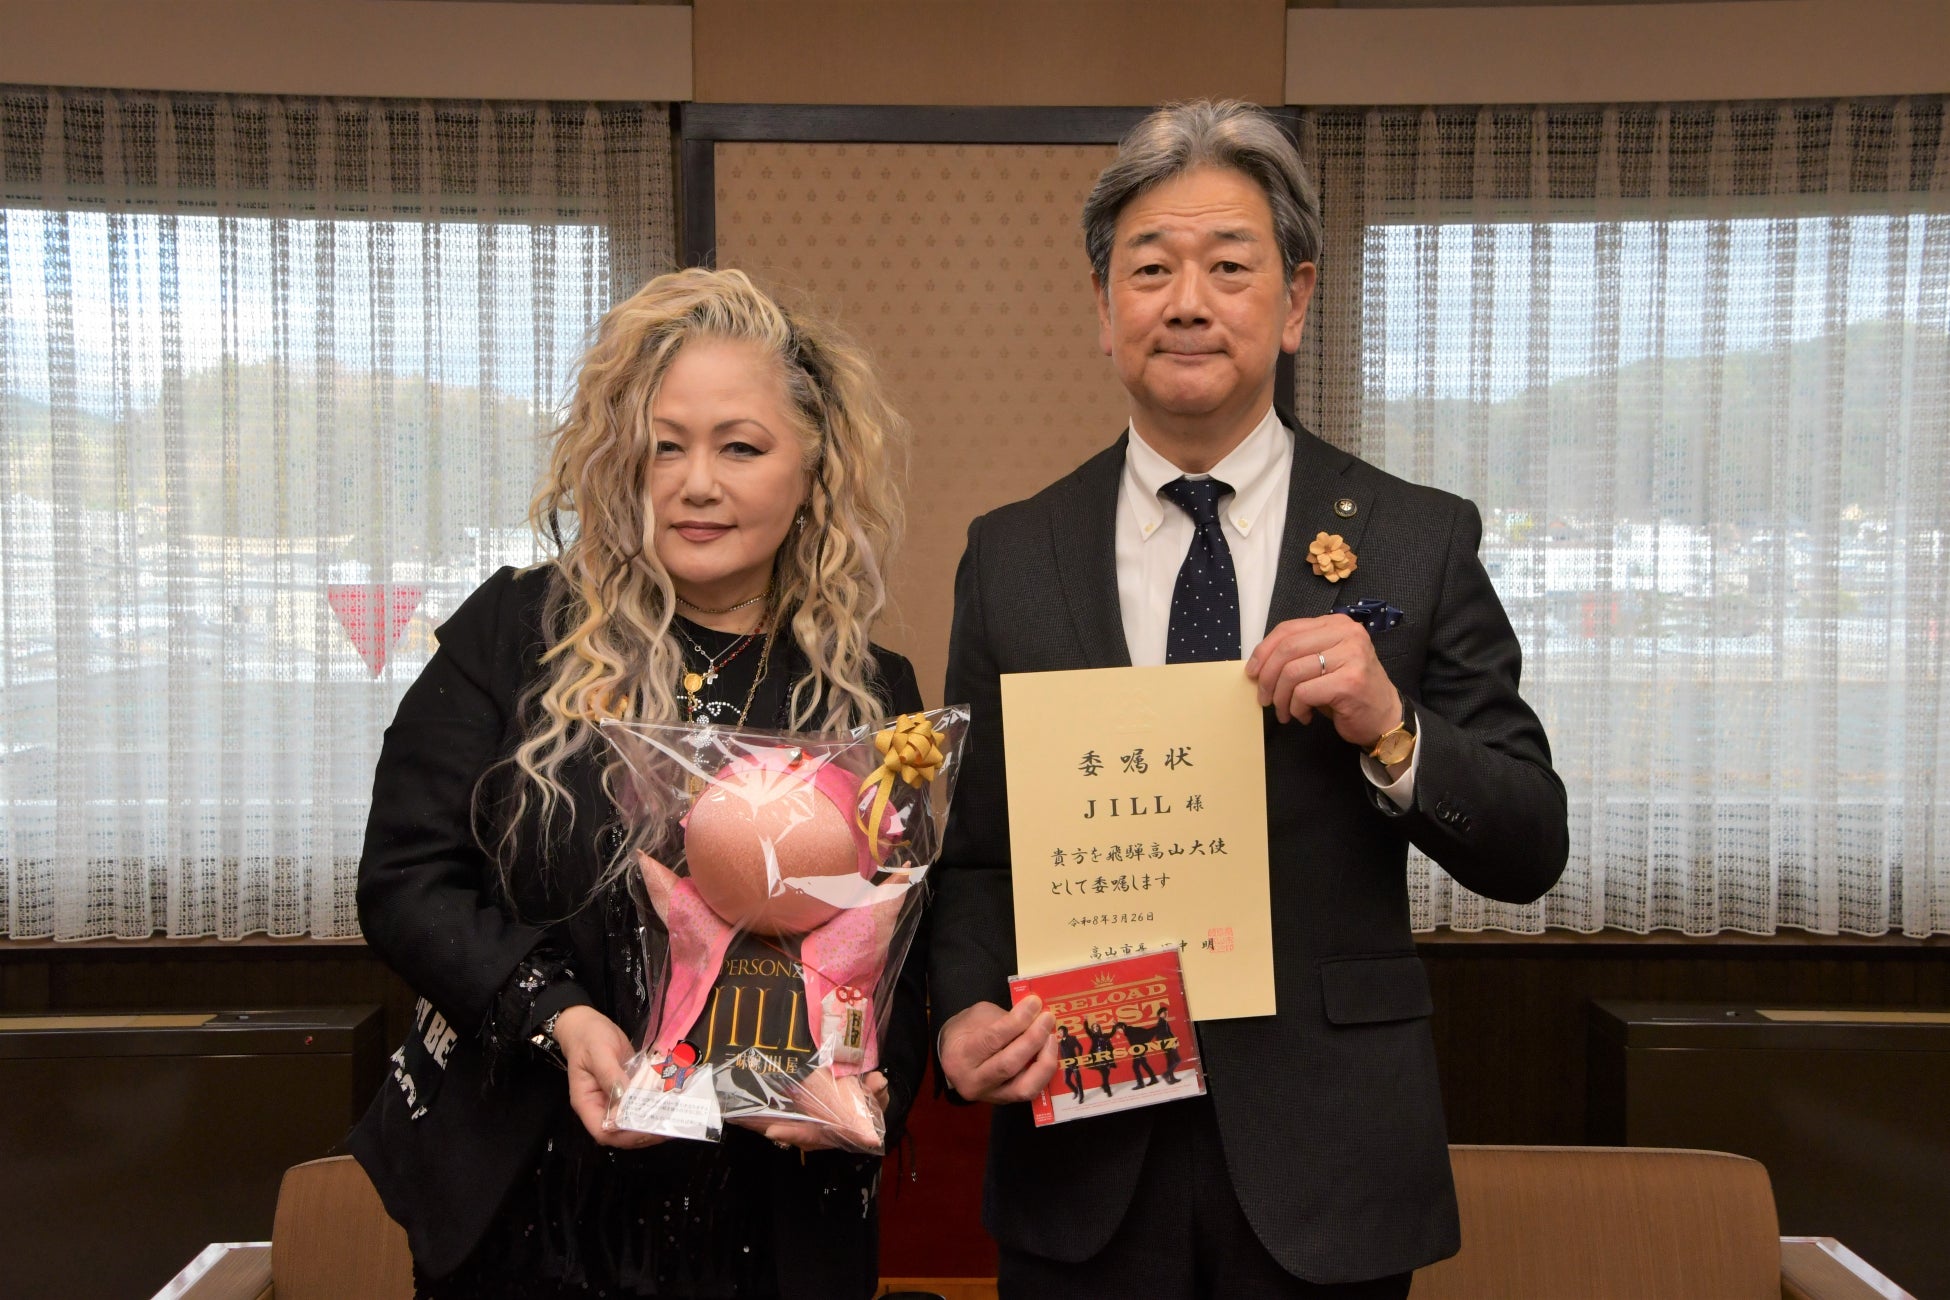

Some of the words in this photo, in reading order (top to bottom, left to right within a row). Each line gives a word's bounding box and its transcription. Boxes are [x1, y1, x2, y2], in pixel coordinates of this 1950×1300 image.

[1078, 747, 1194, 777] 委嘱状
[1084, 796, 1172, 819] JILL
[1186, 794, 1205, 812] 様
[1050, 838, 1228, 867] 貴方を飛騨高山大使
[1051, 873, 1171, 895] として委嘱します
[1068, 912, 1155, 928] 令和8年3月26日
[1048, 983, 1167, 1015] RELOAD
[702, 986, 811, 1064] JILL
[1056, 998, 1170, 1034] BEST
[1058, 1037, 1180, 1070] PERSONZ
